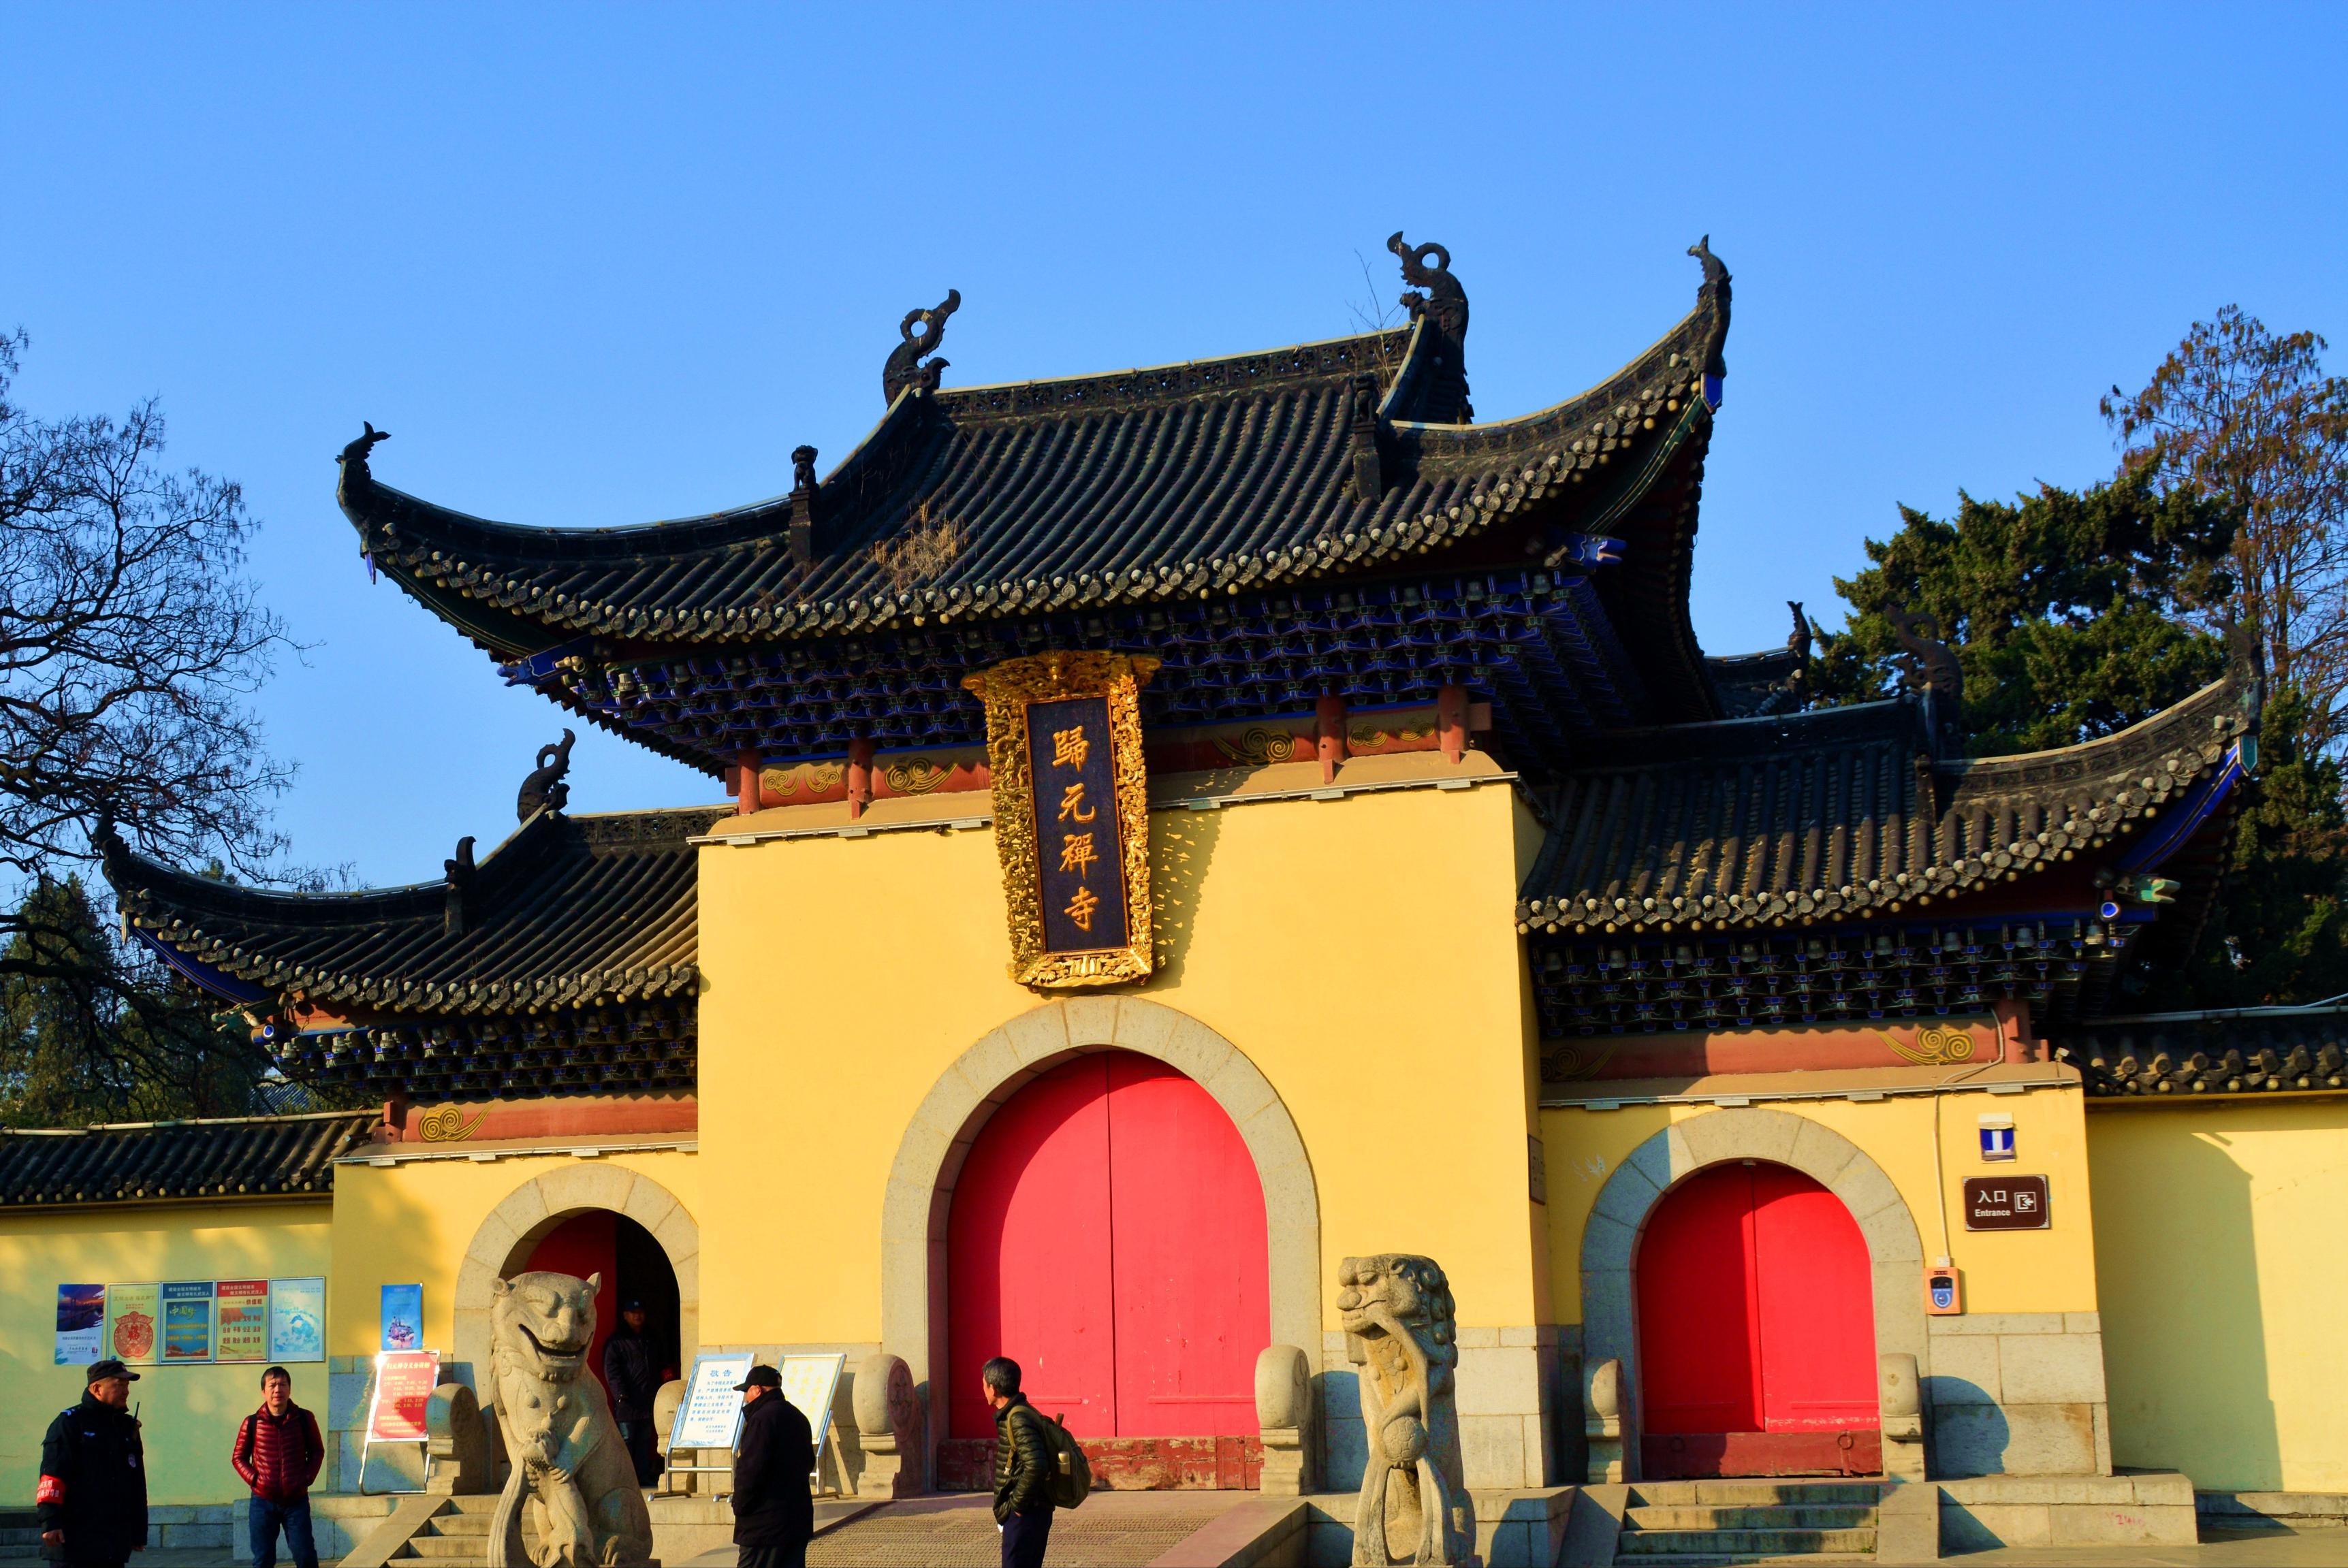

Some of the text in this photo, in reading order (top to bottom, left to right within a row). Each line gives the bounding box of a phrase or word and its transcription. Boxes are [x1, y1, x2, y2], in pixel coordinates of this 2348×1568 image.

[1052, 725, 1100, 932] 歸元禪寺
[1978, 1190, 2006, 1203] 入口
[1975, 1209, 2011, 1217] Entrance
